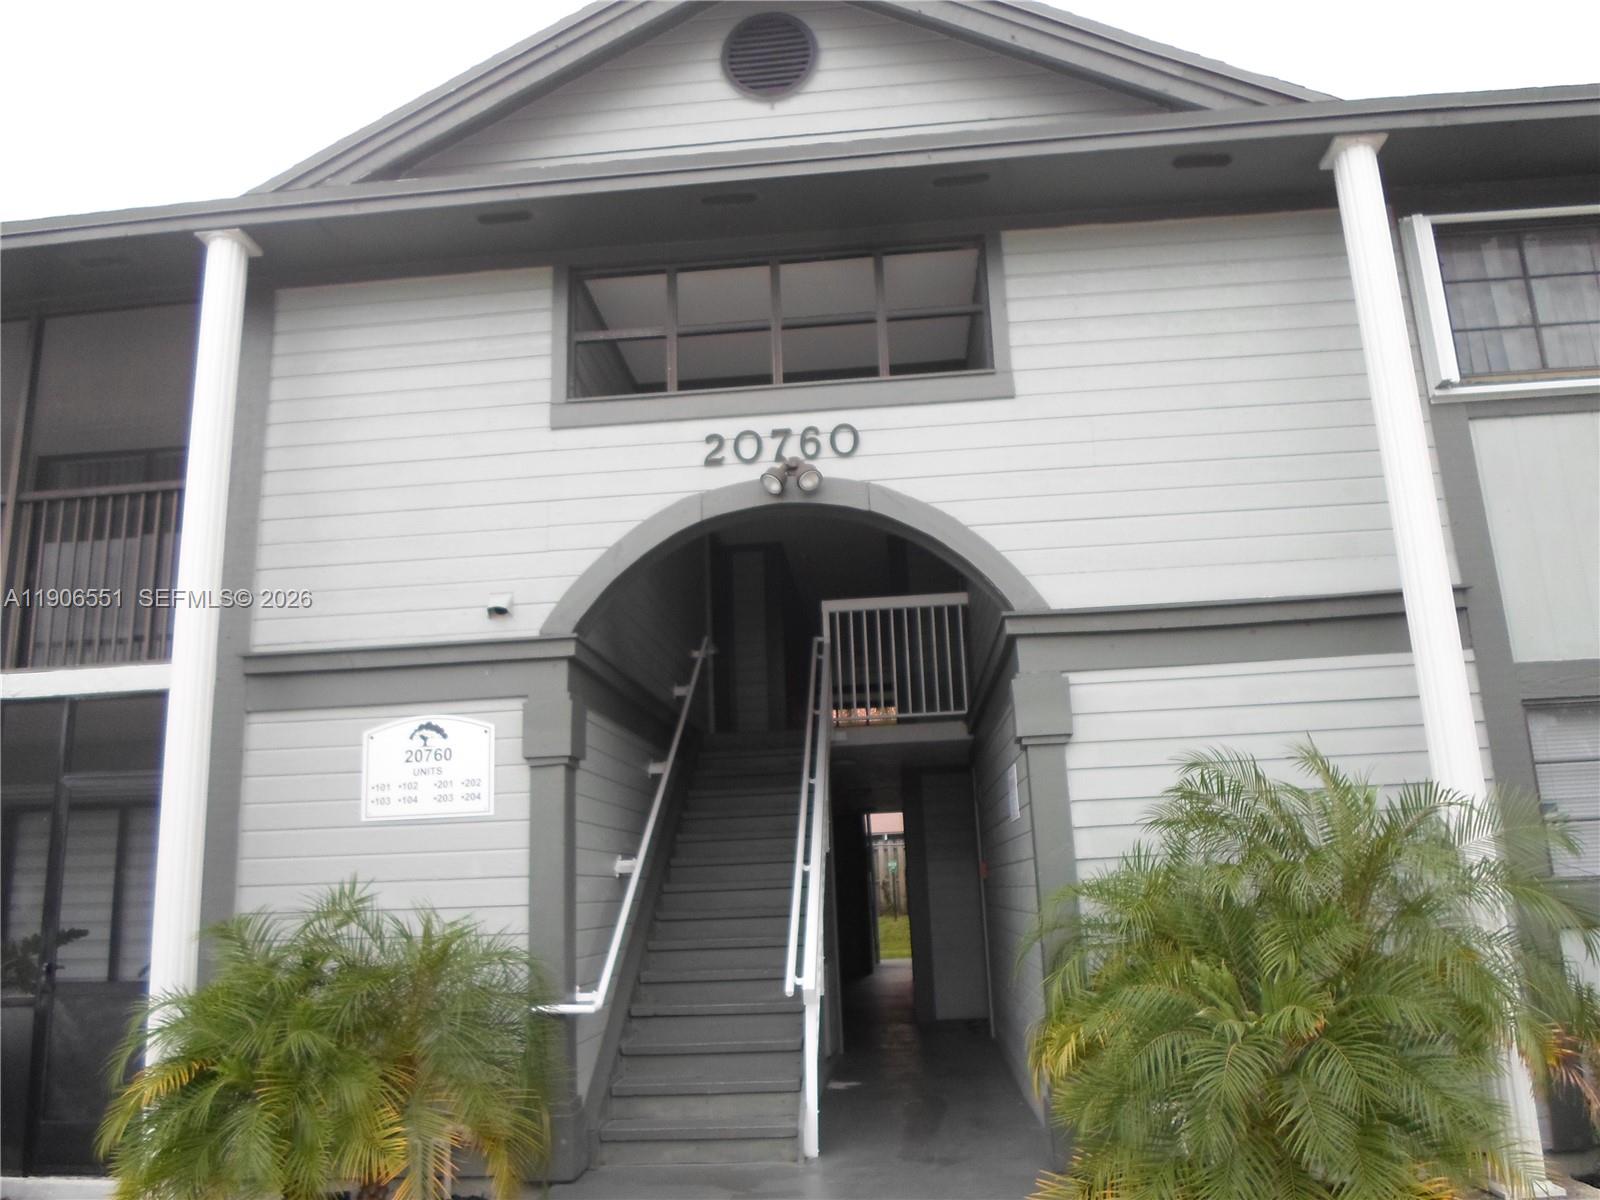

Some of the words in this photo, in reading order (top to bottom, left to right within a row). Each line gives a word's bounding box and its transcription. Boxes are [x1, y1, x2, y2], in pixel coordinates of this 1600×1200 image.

[704, 423, 859, 467] 20760
[405, 747, 453, 763] 20760
[413, 766, 443, 777] UNITS
